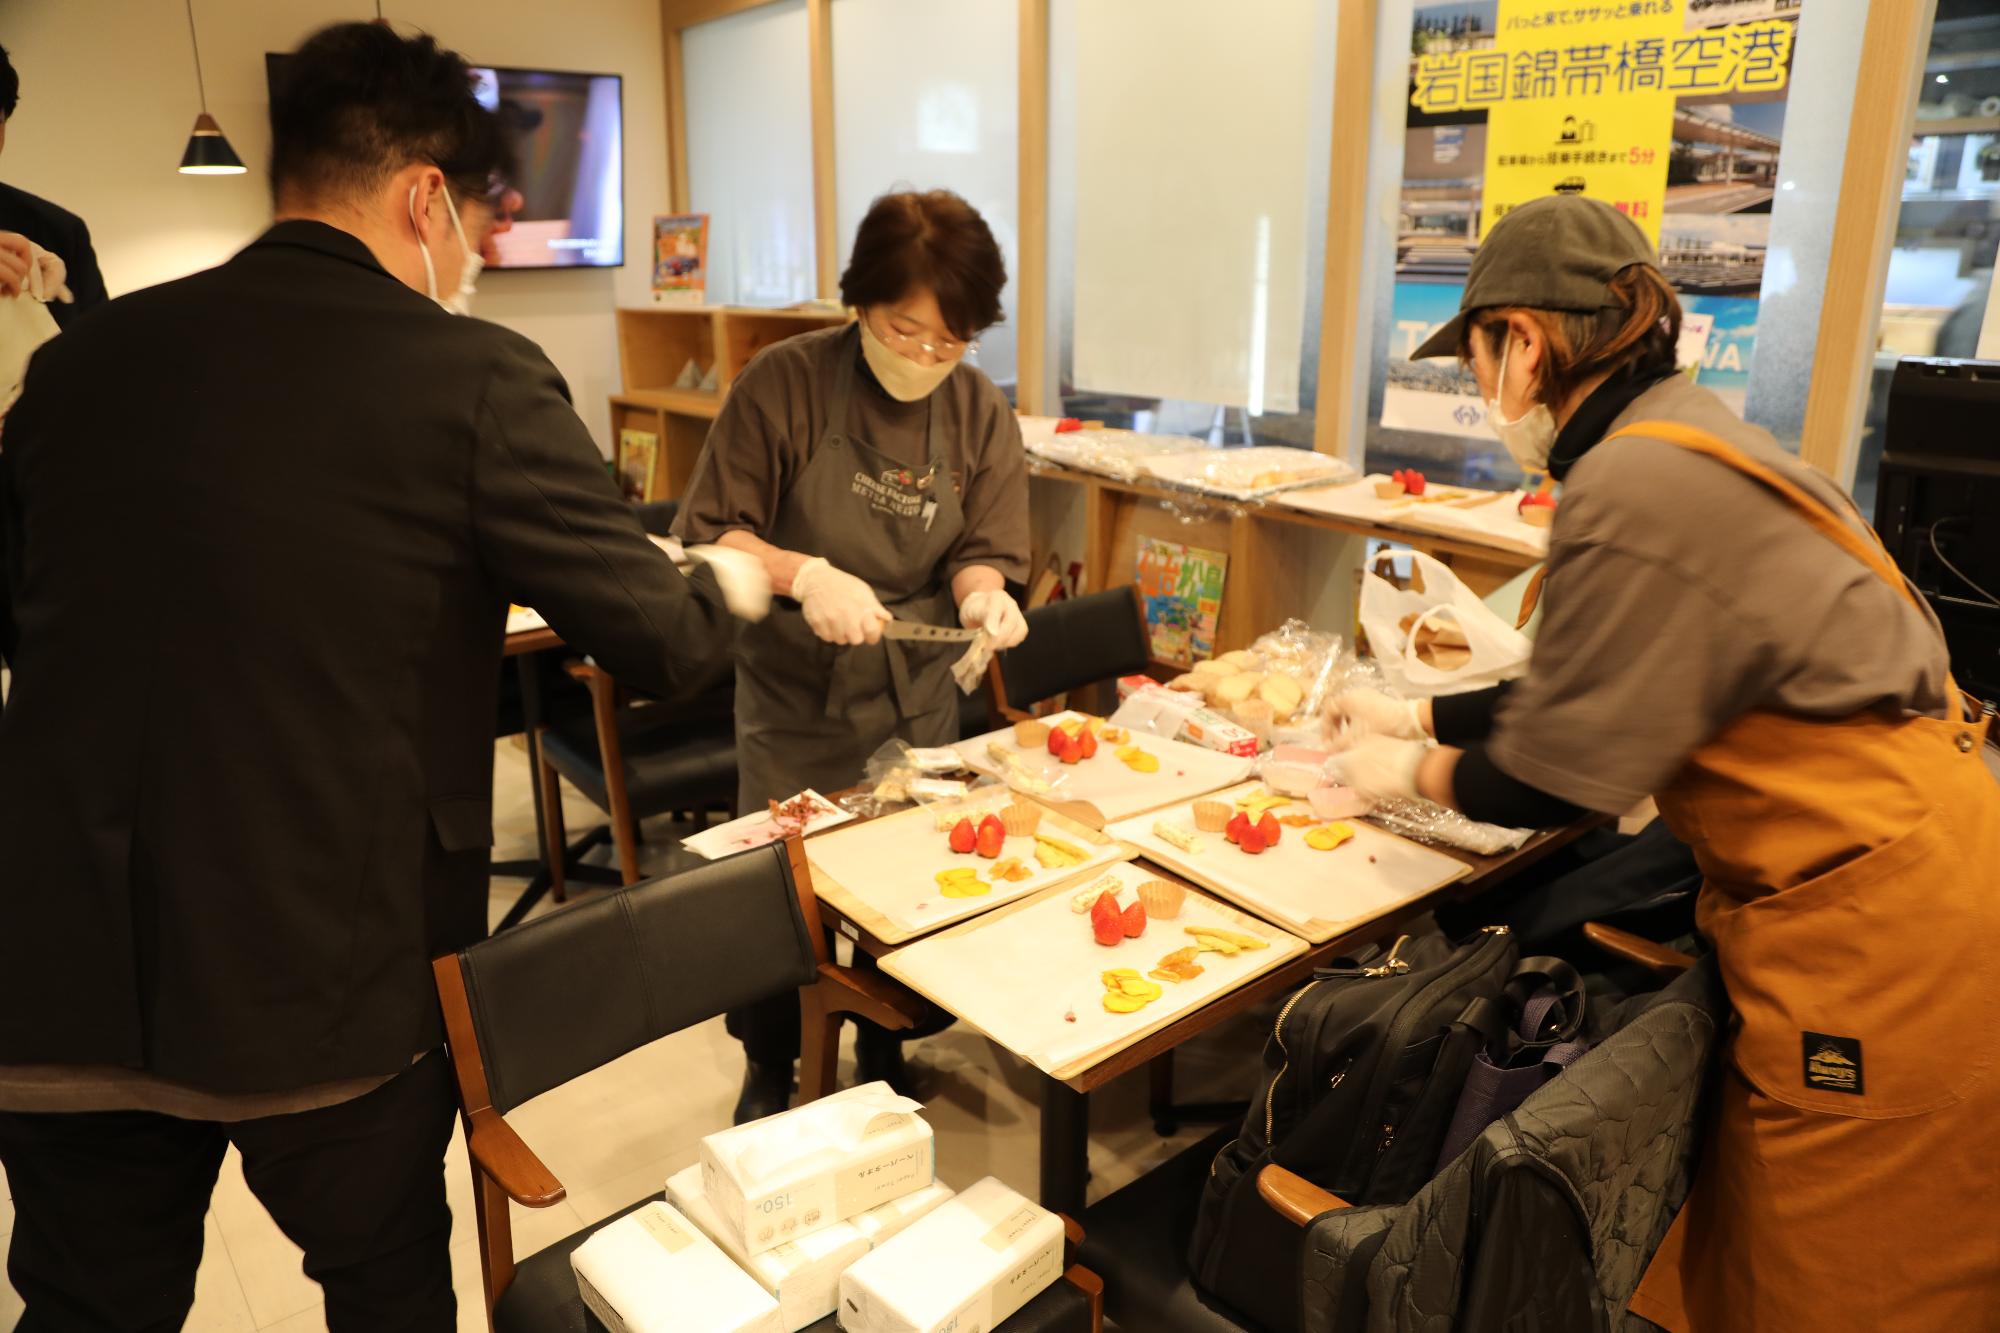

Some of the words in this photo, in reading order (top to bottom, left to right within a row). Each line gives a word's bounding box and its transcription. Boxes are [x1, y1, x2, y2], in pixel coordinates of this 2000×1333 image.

[1418, 28, 1786, 107] 岩国錦帯橋空港
[857, 1153, 914, 1179] ペーパータオル
